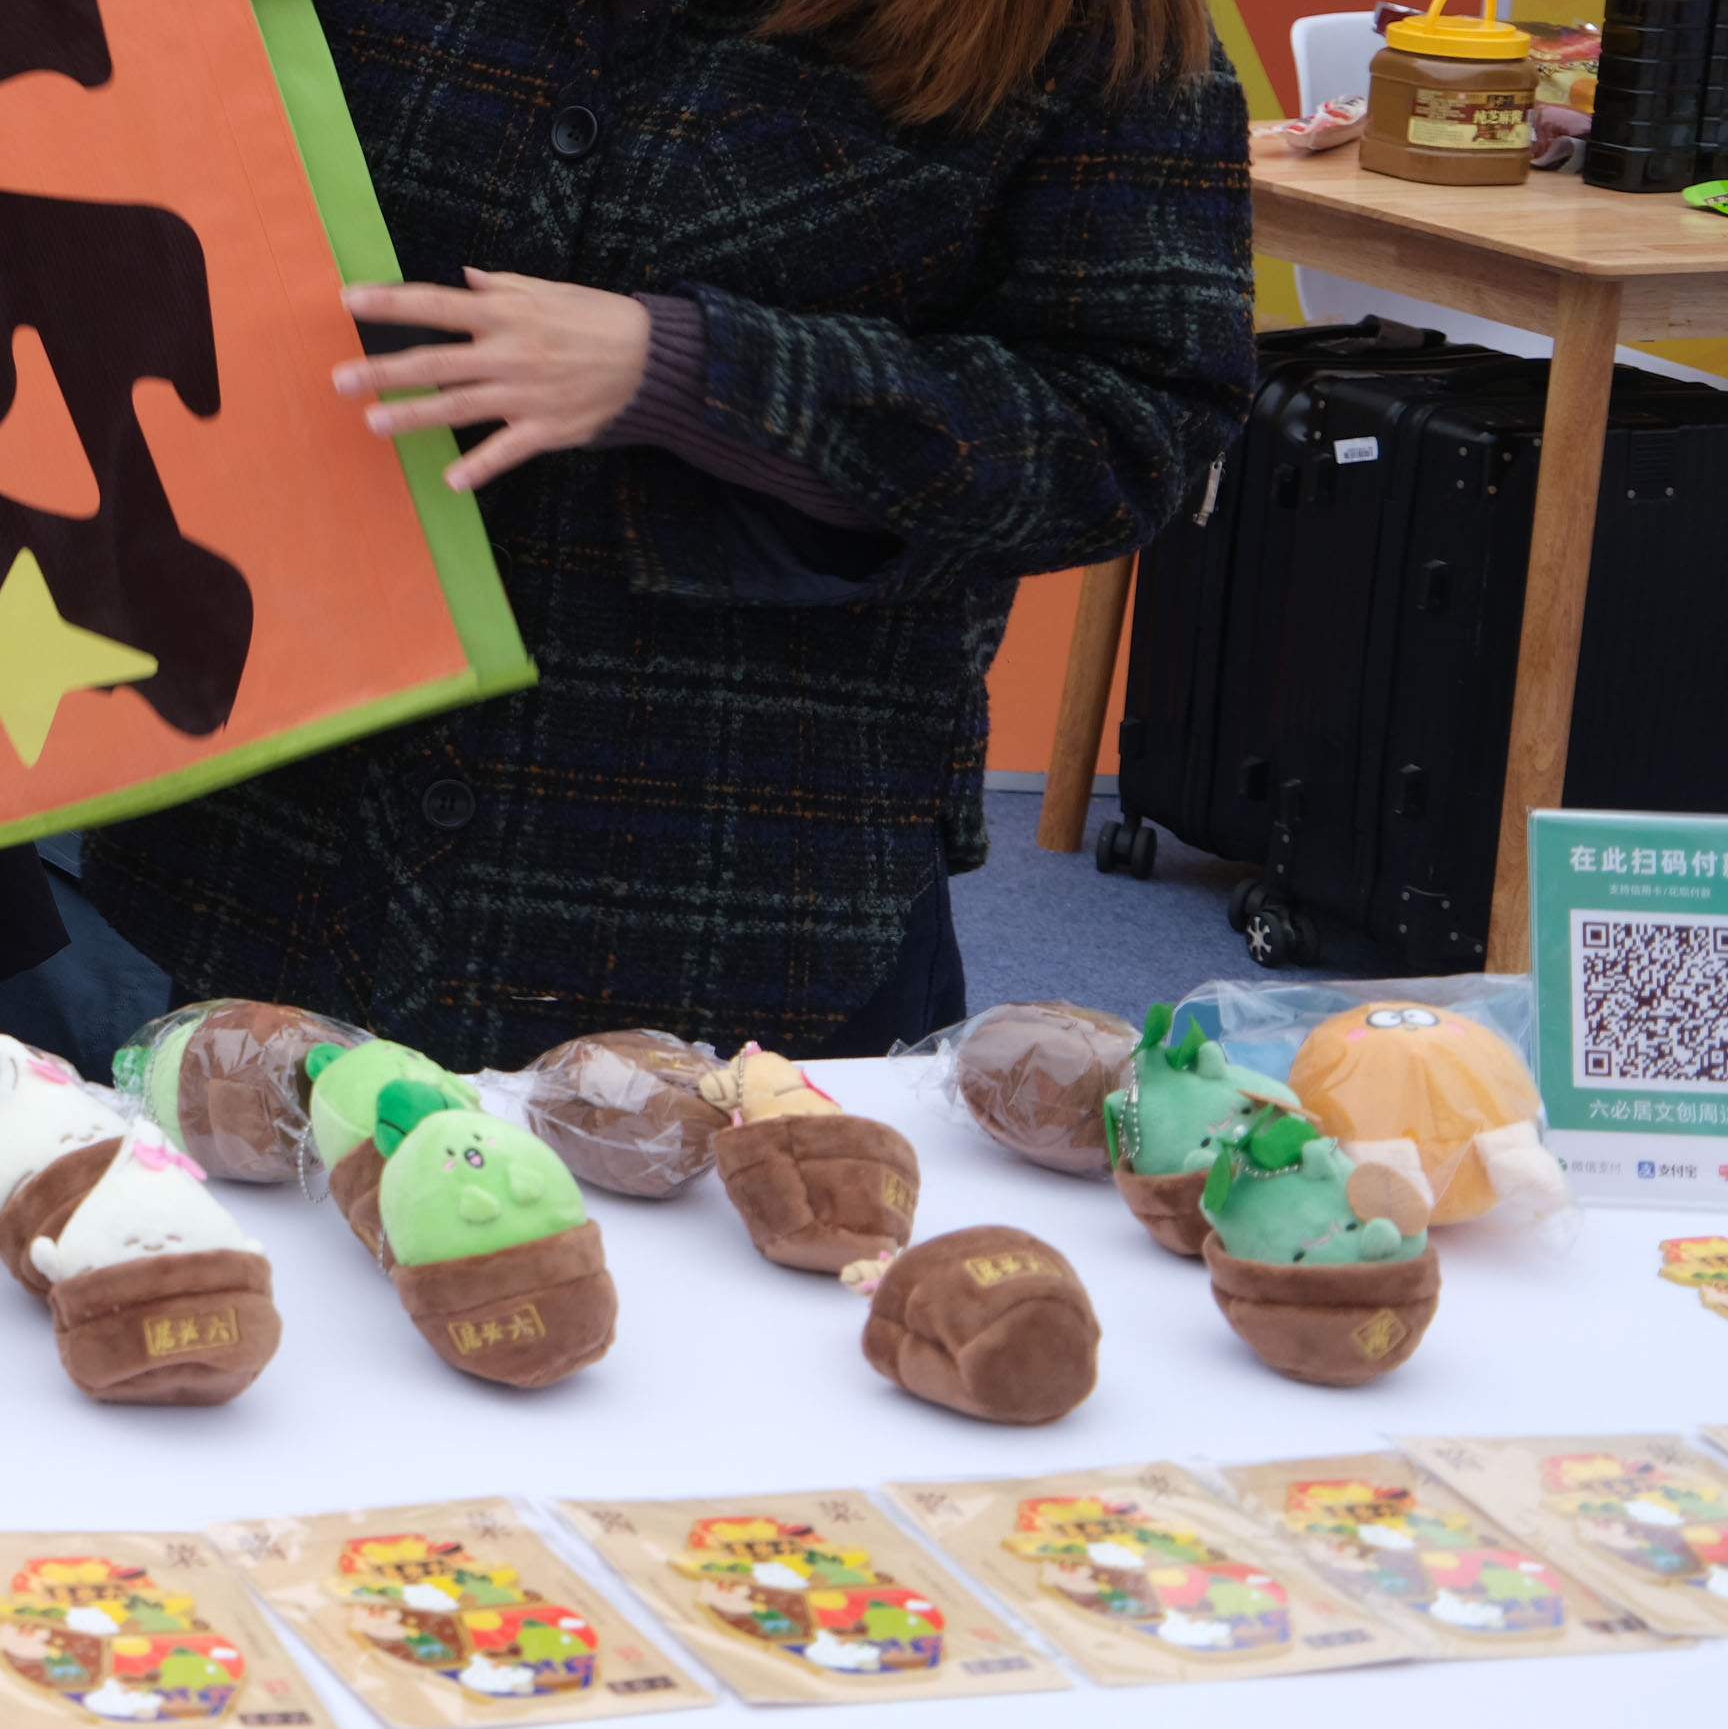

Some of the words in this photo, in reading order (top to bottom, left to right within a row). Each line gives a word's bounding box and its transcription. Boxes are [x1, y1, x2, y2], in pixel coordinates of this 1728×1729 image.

[1570, 845, 1728, 878] 在此扫码付
[1658, 1164, 1698, 1179] 支付宝
